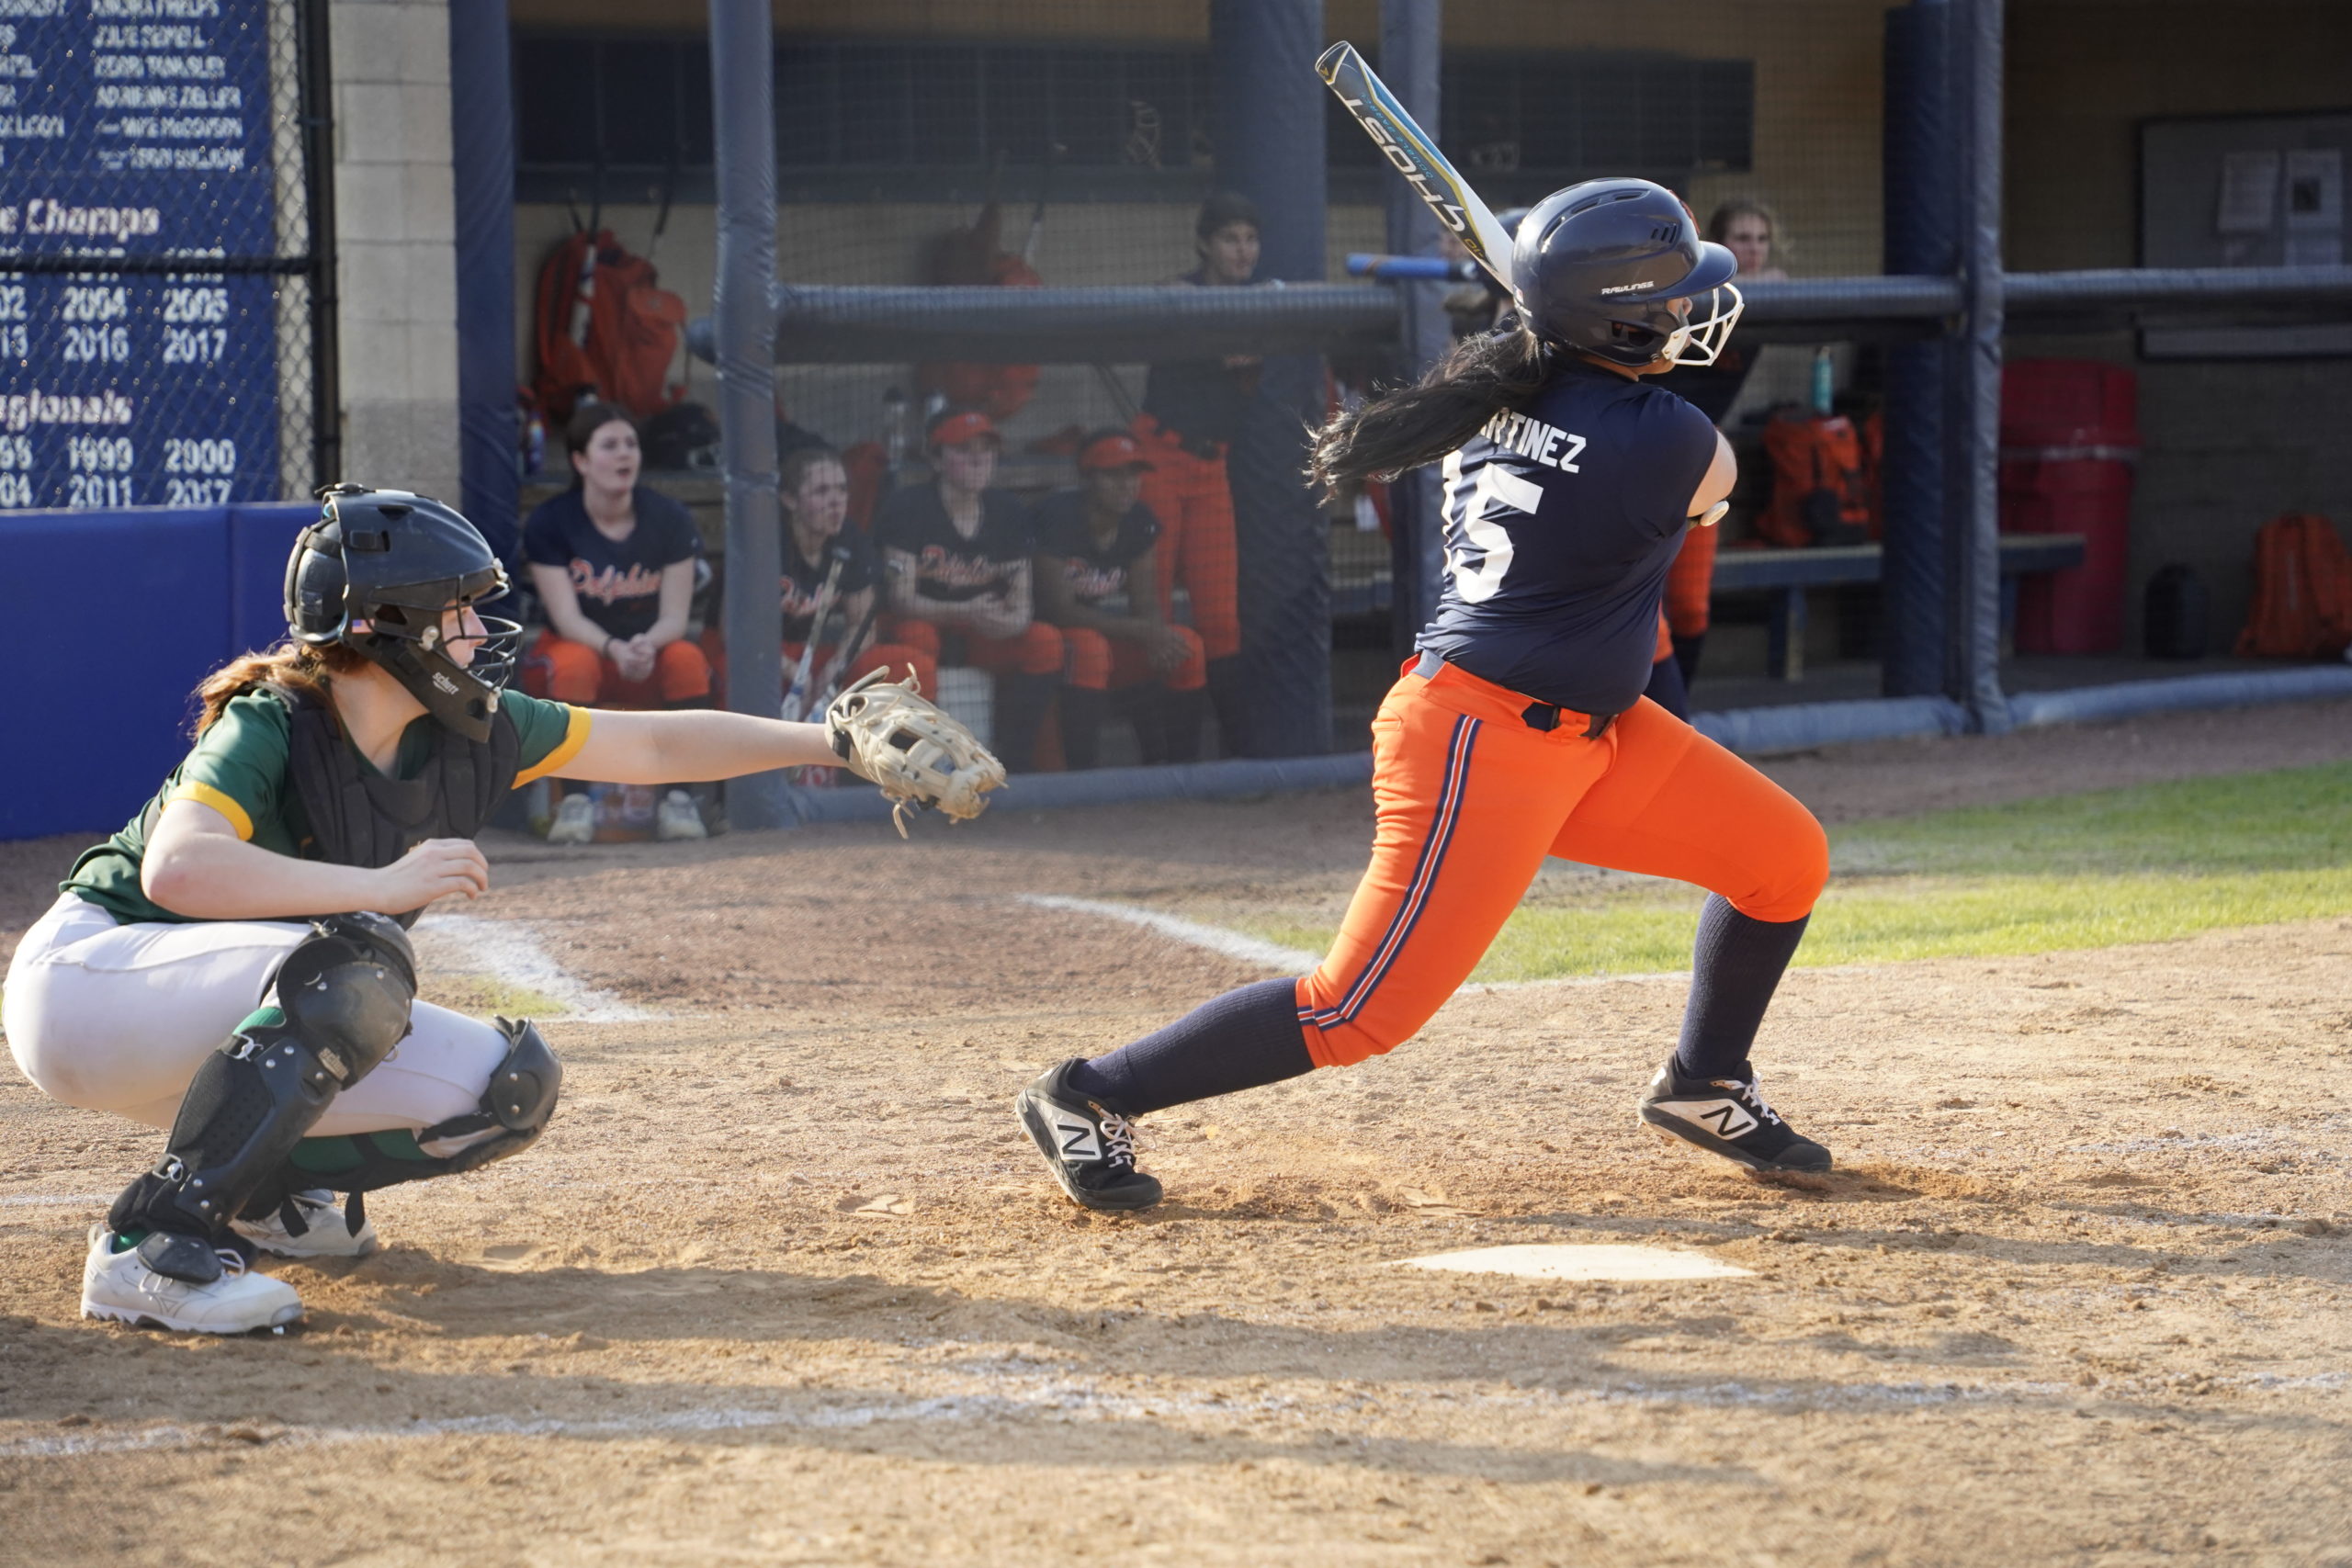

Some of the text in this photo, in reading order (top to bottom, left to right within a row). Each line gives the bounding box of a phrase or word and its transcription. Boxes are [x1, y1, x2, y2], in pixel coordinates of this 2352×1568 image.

[1337, 92, 1465, 231] GHOST
[0, 286, 229, 323] 02 2004 2005
[1, 325, 228, 364] 13 2016 2017
[164, 438, 236, 475] 2000
[1480, 407, 1587, 474] RTINEZ
[0, 472, 33, 508] 04
[68, 474, 132, 508] 2011
